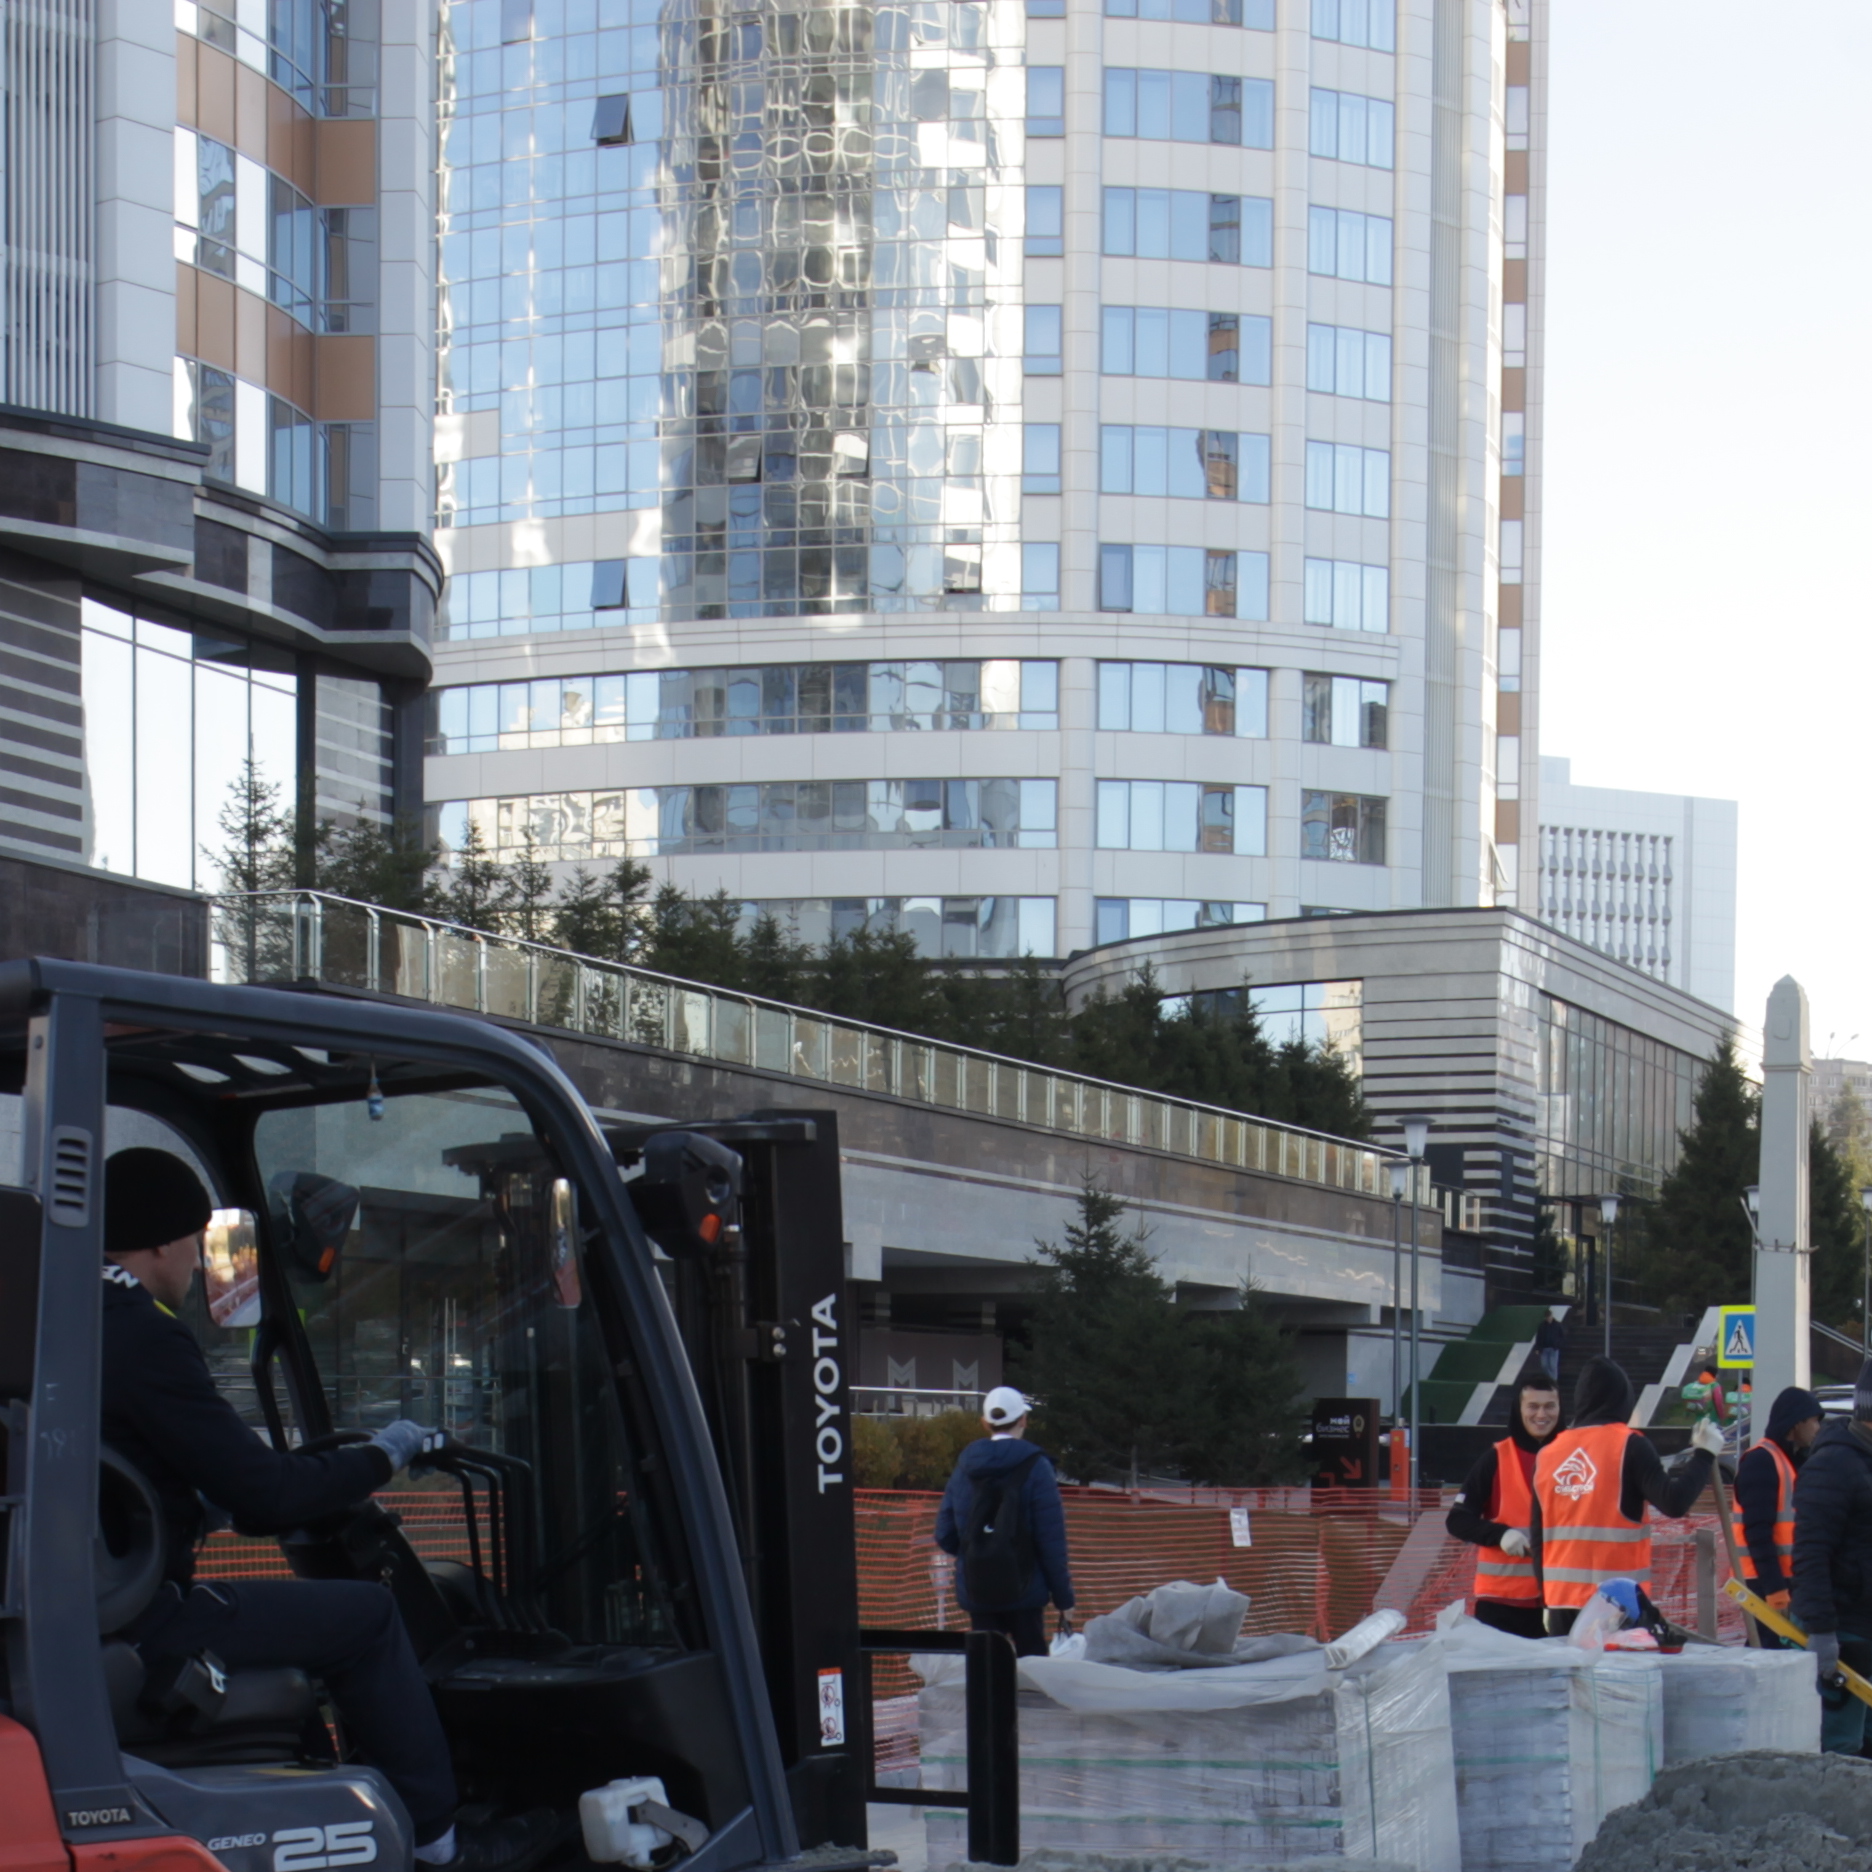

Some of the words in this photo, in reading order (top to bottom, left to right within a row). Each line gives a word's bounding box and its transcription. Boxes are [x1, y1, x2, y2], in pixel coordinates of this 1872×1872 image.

[811, 1292, 843, 1495] TOYOTA
[68, 1808, 131, 1826] TOYOTA
[207, 1833, 266, 1851] GENEO
